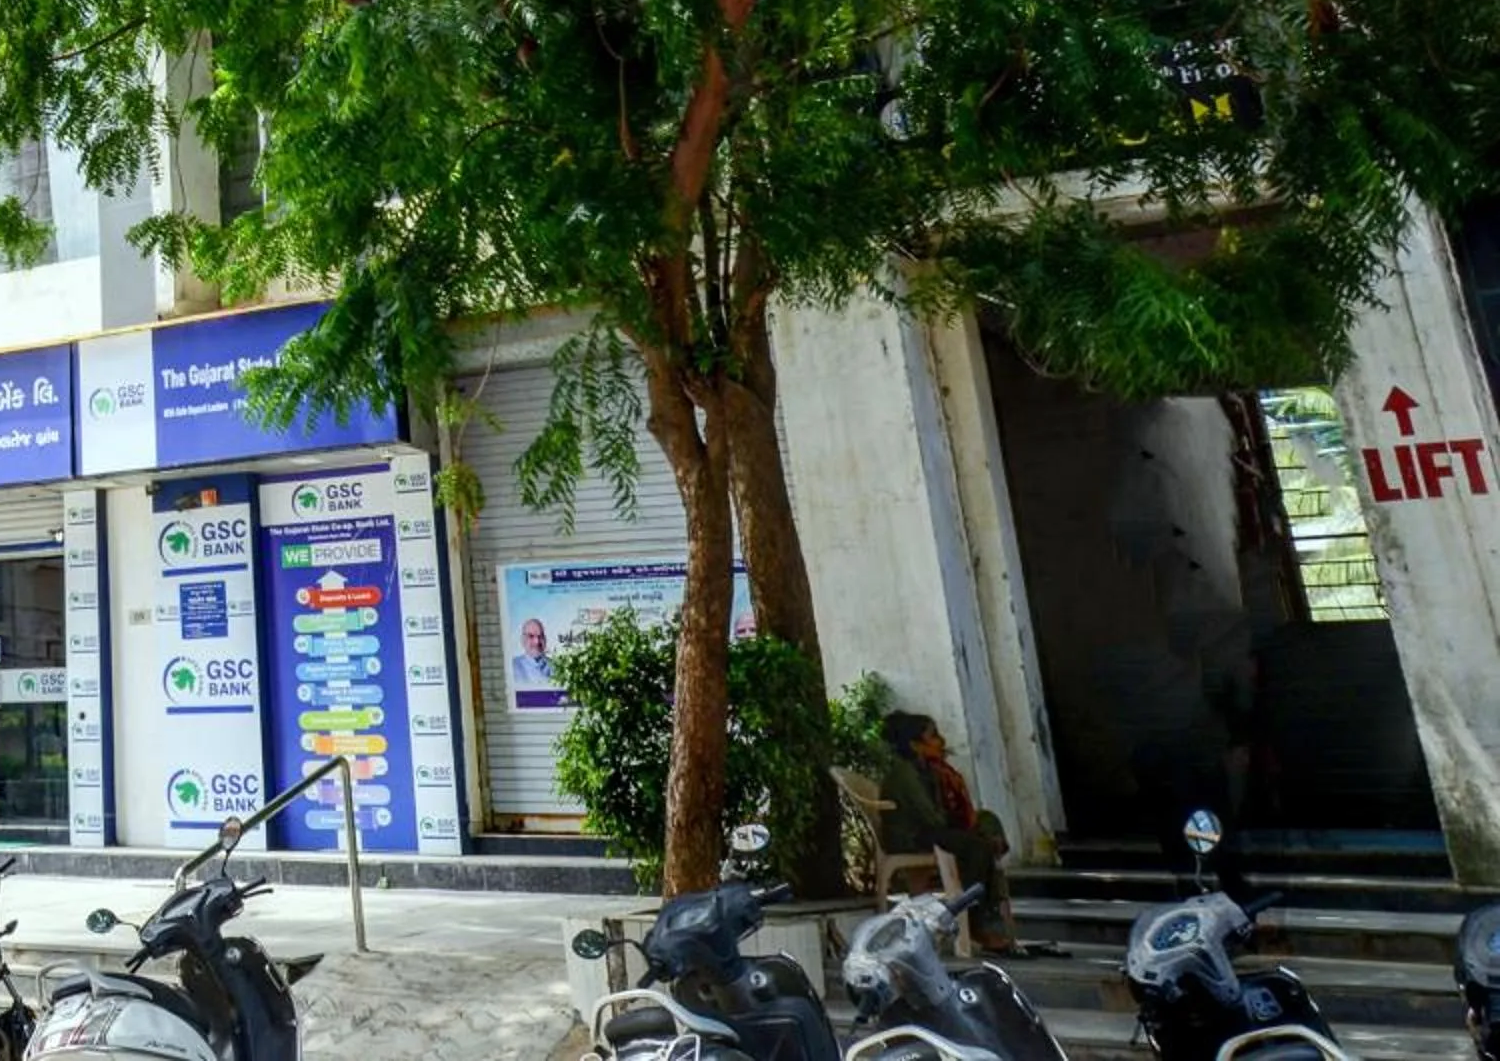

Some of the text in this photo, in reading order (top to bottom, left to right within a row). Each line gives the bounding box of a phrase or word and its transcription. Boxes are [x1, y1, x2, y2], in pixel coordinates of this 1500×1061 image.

[162, 368, 187, 390] The
[188, 360, 235, 389] Gujarat
[117, 383, 145, 400] GSC
[119, 397, 144, 410] BANK
[1361, 438, 1489, 503] LIFT
[326, 482, 363, 500] GSC
[328, 499, 363, 512] BANK
[201, 518, 247, 541] GSC
[203, 541, 245, 557] BANK
[284, 543, 377, 563] WE PROVIDE
[206, 658, 253, 679] GSC
[40, 673, 65, 685] GSC
[209, 681, 252, 696] BANK
[211, 774, 259, 795] GSC
[213, 797, 257, 812] BANK
